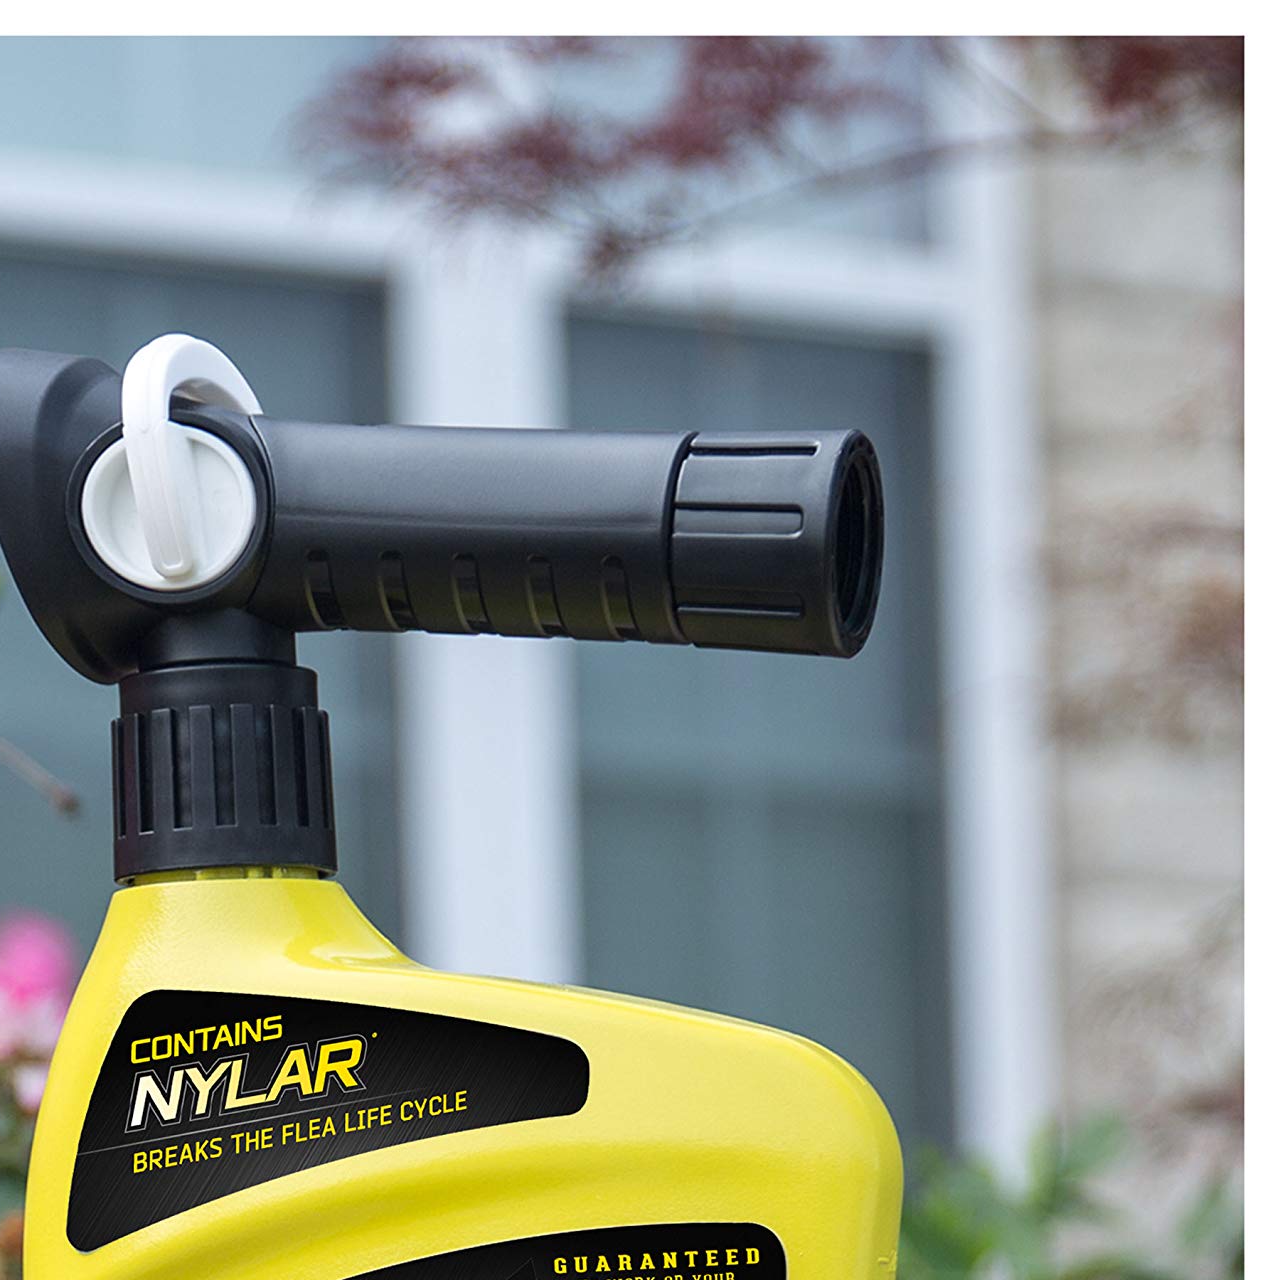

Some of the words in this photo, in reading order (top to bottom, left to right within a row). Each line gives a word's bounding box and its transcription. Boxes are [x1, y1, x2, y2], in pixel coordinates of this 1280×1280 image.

[131, 1015, 283, 1064] CONTAINS
[134, 1138, 222, 1173] BREAKS
[231, 1128, 273, 1154] THE
[282, 1117, 336, 1145] FLEA
[345, 1105, 392, 1132] LIFE
[401, 1091, 467, 1121] CYCLE
[554, 1248, 759, 1274] GUARANTEED
